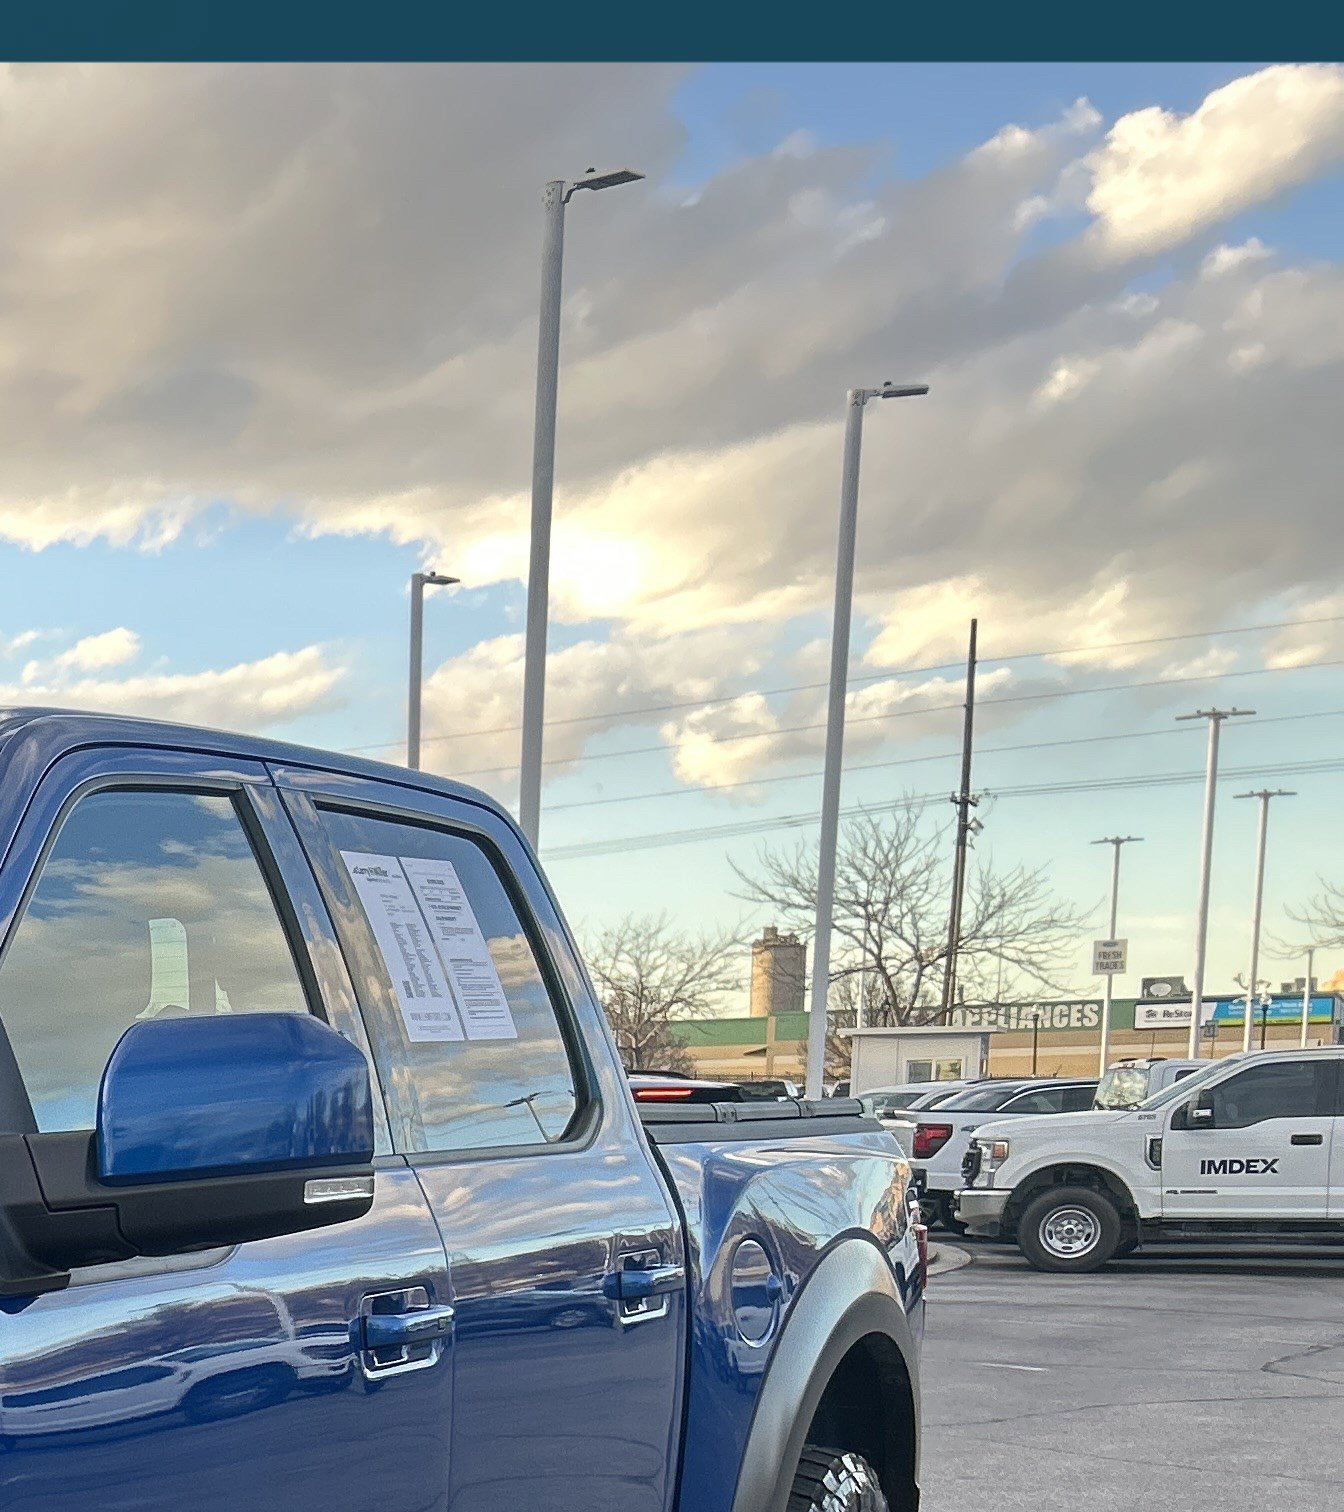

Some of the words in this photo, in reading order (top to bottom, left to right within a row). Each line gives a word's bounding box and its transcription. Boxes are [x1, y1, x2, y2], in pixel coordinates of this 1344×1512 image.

[949, 1004, 1099, 1029] APPLIANCES
[1162, 1009, 1192, 1018] ReSto
[1200, 1158, 1280, 1175] IMDEX
